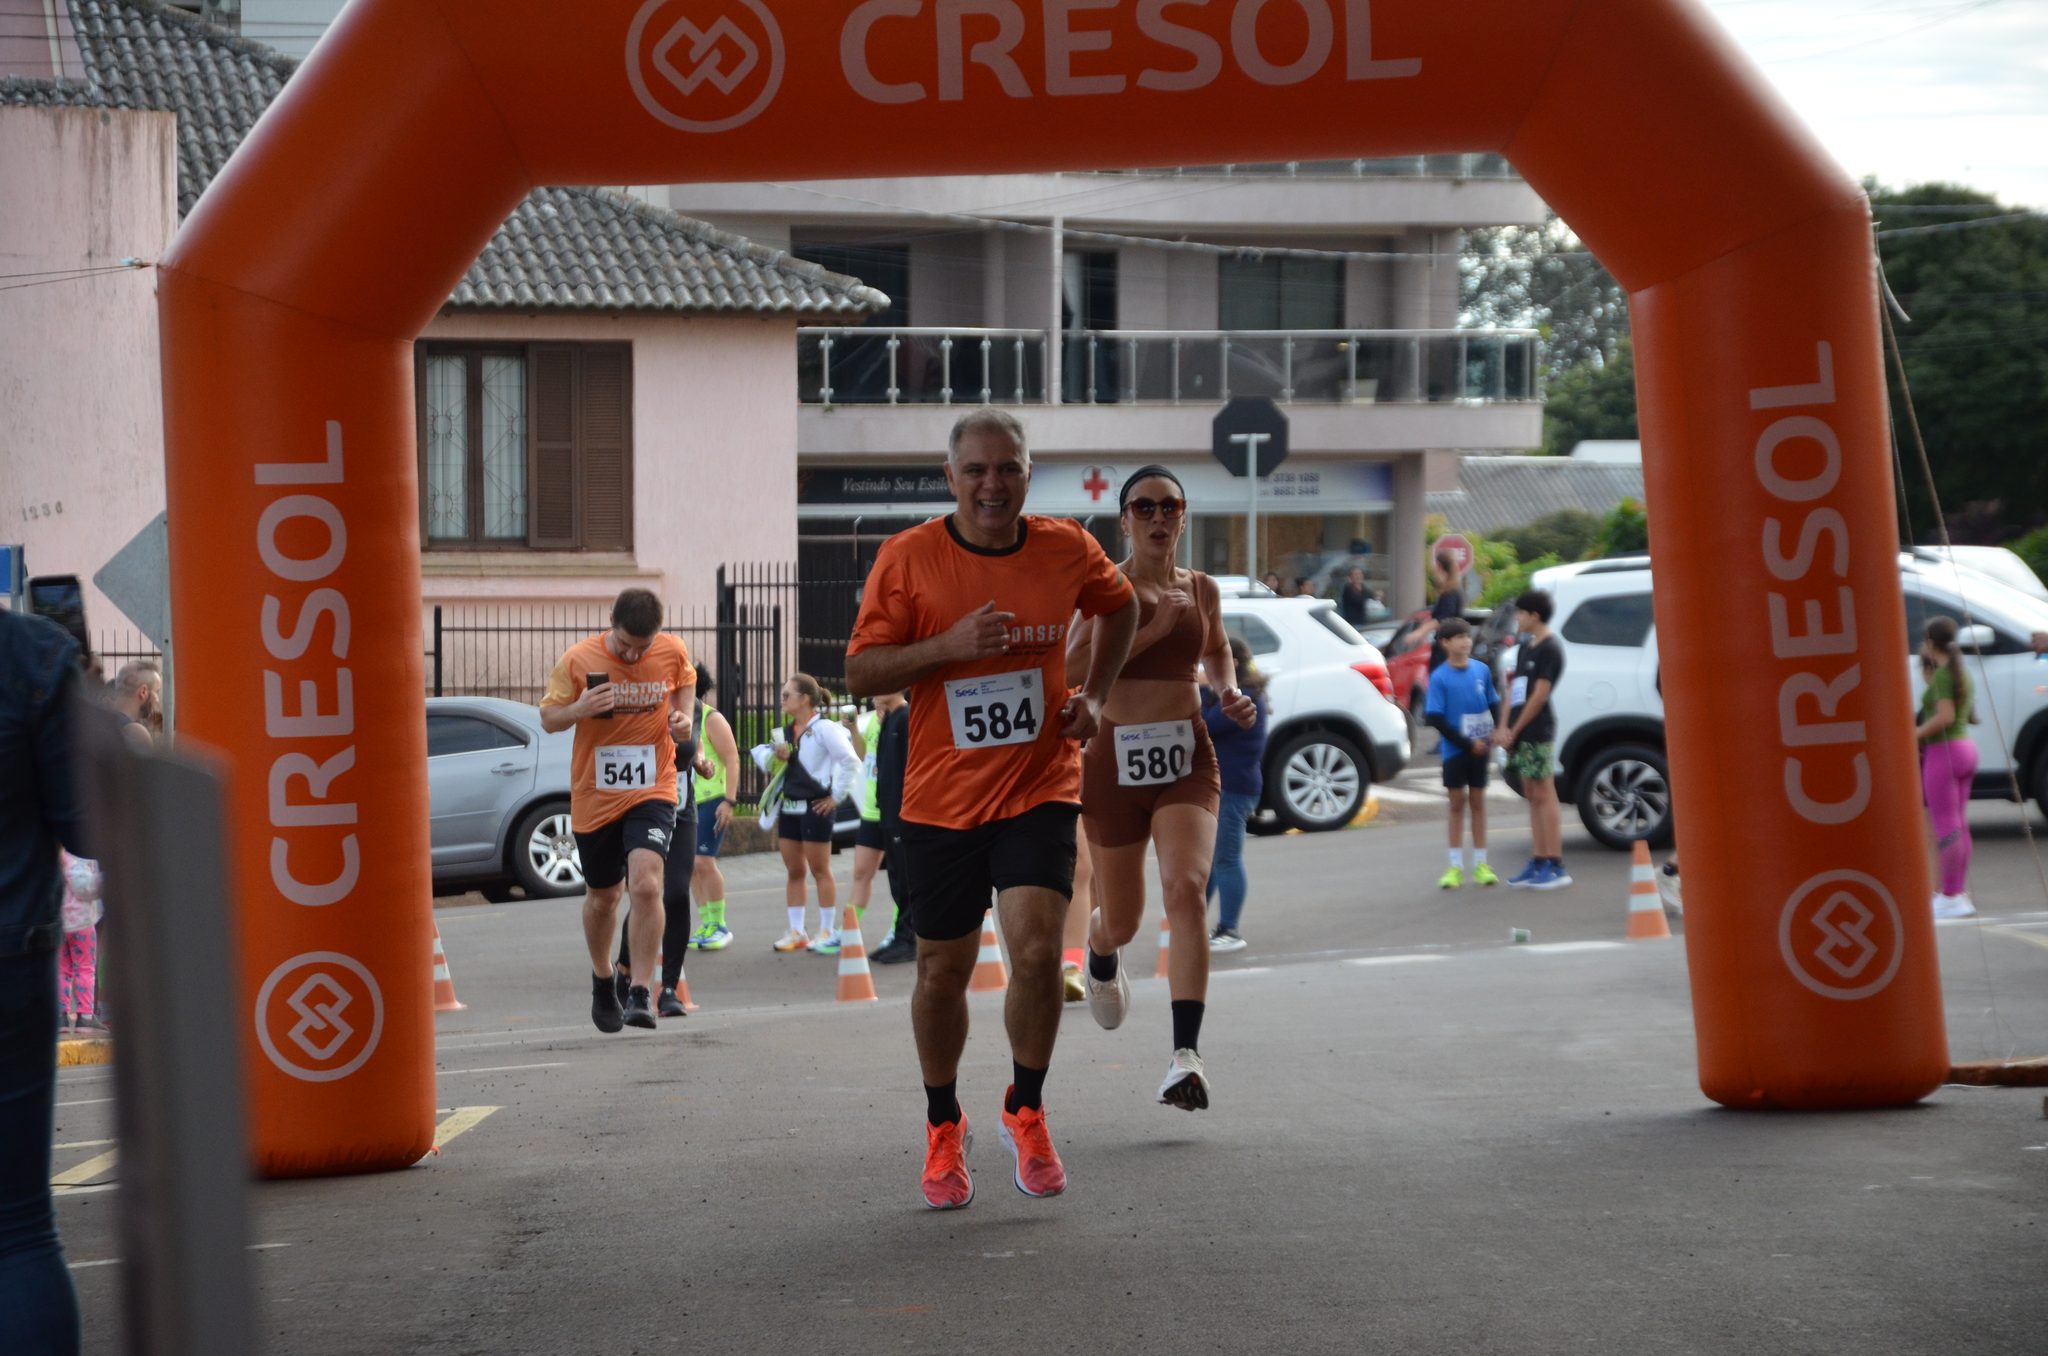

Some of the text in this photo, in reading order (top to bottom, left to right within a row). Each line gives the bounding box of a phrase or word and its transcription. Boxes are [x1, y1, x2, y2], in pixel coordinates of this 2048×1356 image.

[839, 0, 1422, 104] CRESOL
[843, 477, 892, 491] Vestindo
[894, 477, 914, 490] Seu
[1749, 340, 1872, 825] CRESOL
[254, 420, 361, 907] CRESOL
[611, 679, 668, 694] RÚSTICA
[614, 693, 664, 705] GIONAL
[964, 697, 1036, 742] 584
[604, 762, 645, 785] 541
[1128, 744, 1185, 781] 580
